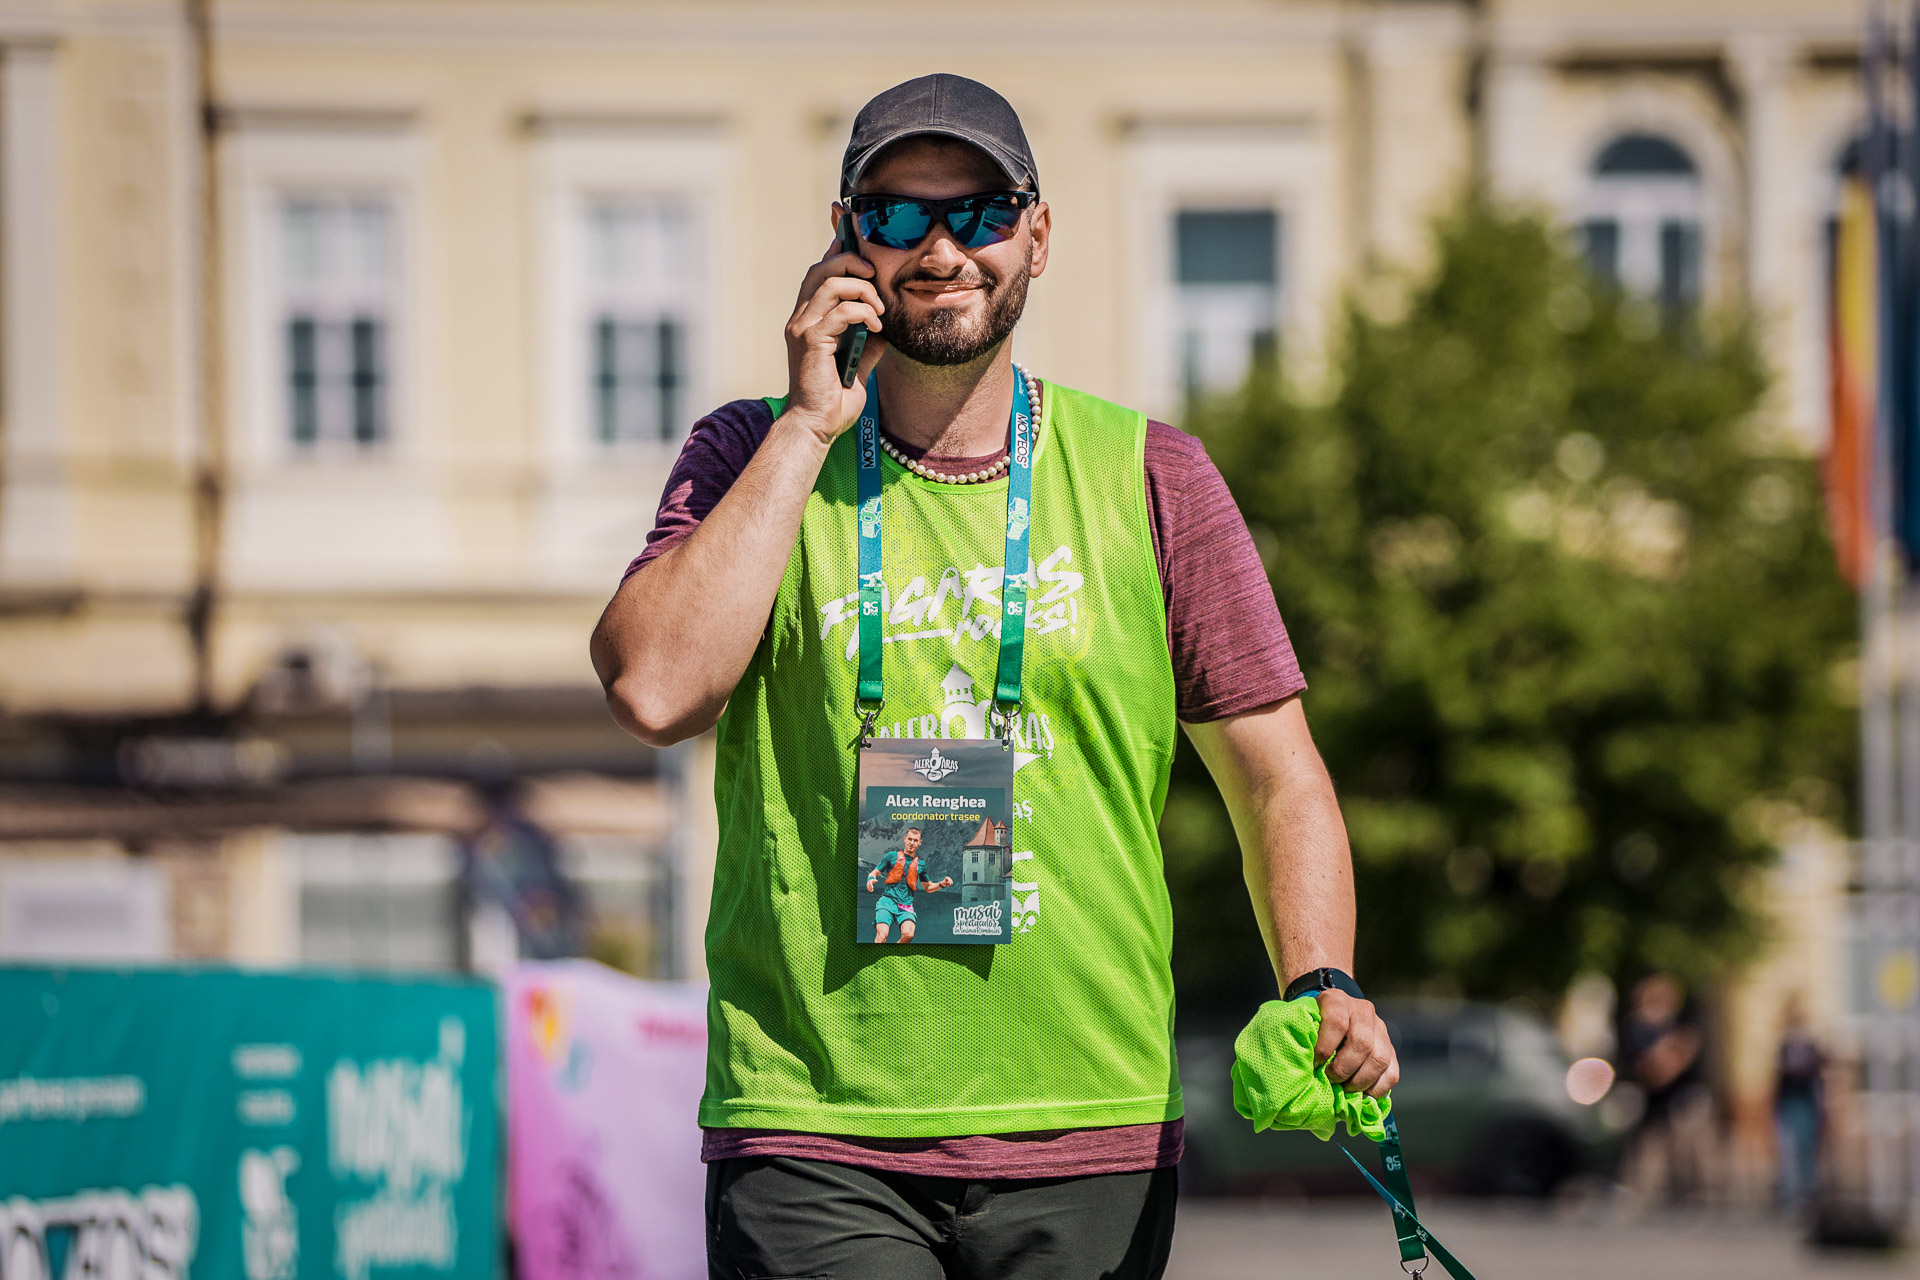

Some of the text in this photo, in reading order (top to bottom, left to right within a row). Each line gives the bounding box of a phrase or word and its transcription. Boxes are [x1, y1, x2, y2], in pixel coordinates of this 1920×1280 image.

[862, 418, 875, 468] MOVEOS
[1016, 412, 1029, 467] MOVEOS
[885, 794, 987, 810] Alex Renghea
[891, 811, 981, 822] coordonator trasee
